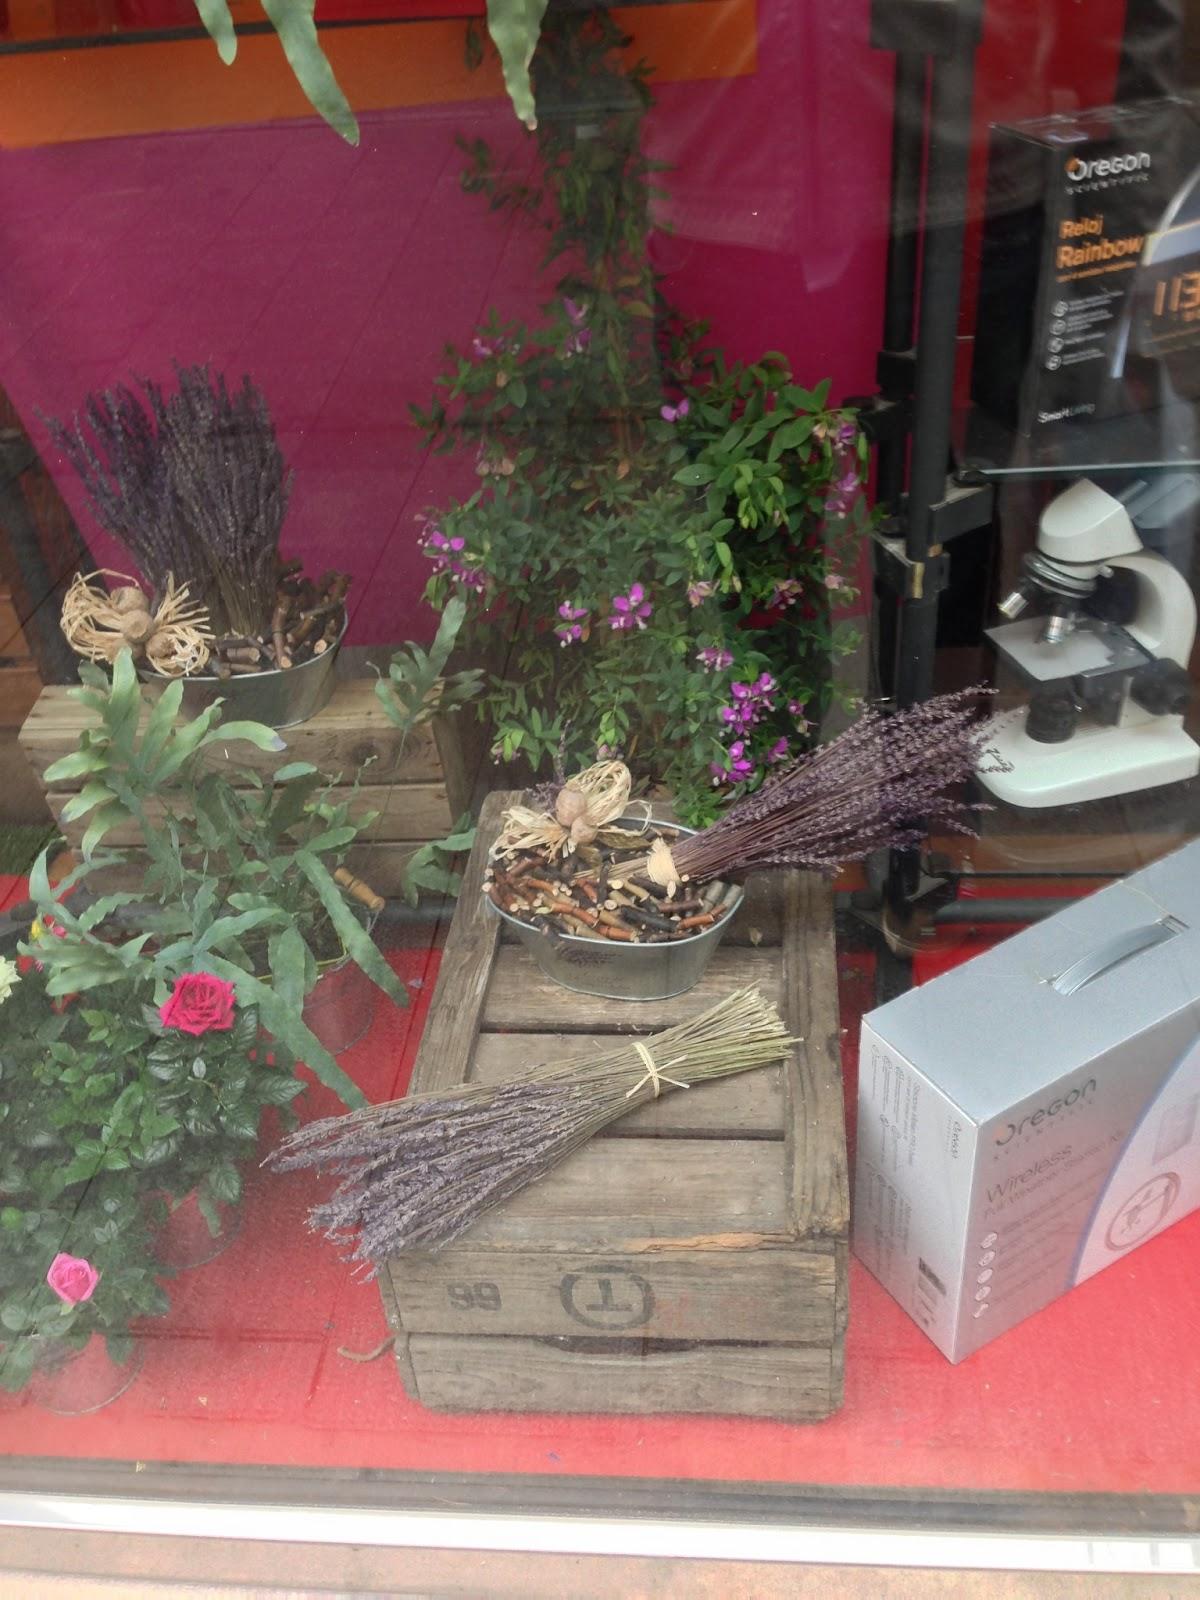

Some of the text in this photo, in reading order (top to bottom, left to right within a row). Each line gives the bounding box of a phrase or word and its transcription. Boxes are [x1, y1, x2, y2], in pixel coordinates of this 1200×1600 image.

[1060, 215, 1103, 239] Reloj
[1056, 236, 1143, 268] Rainbow
[986, 1145, 1073, 1203] Wireless
